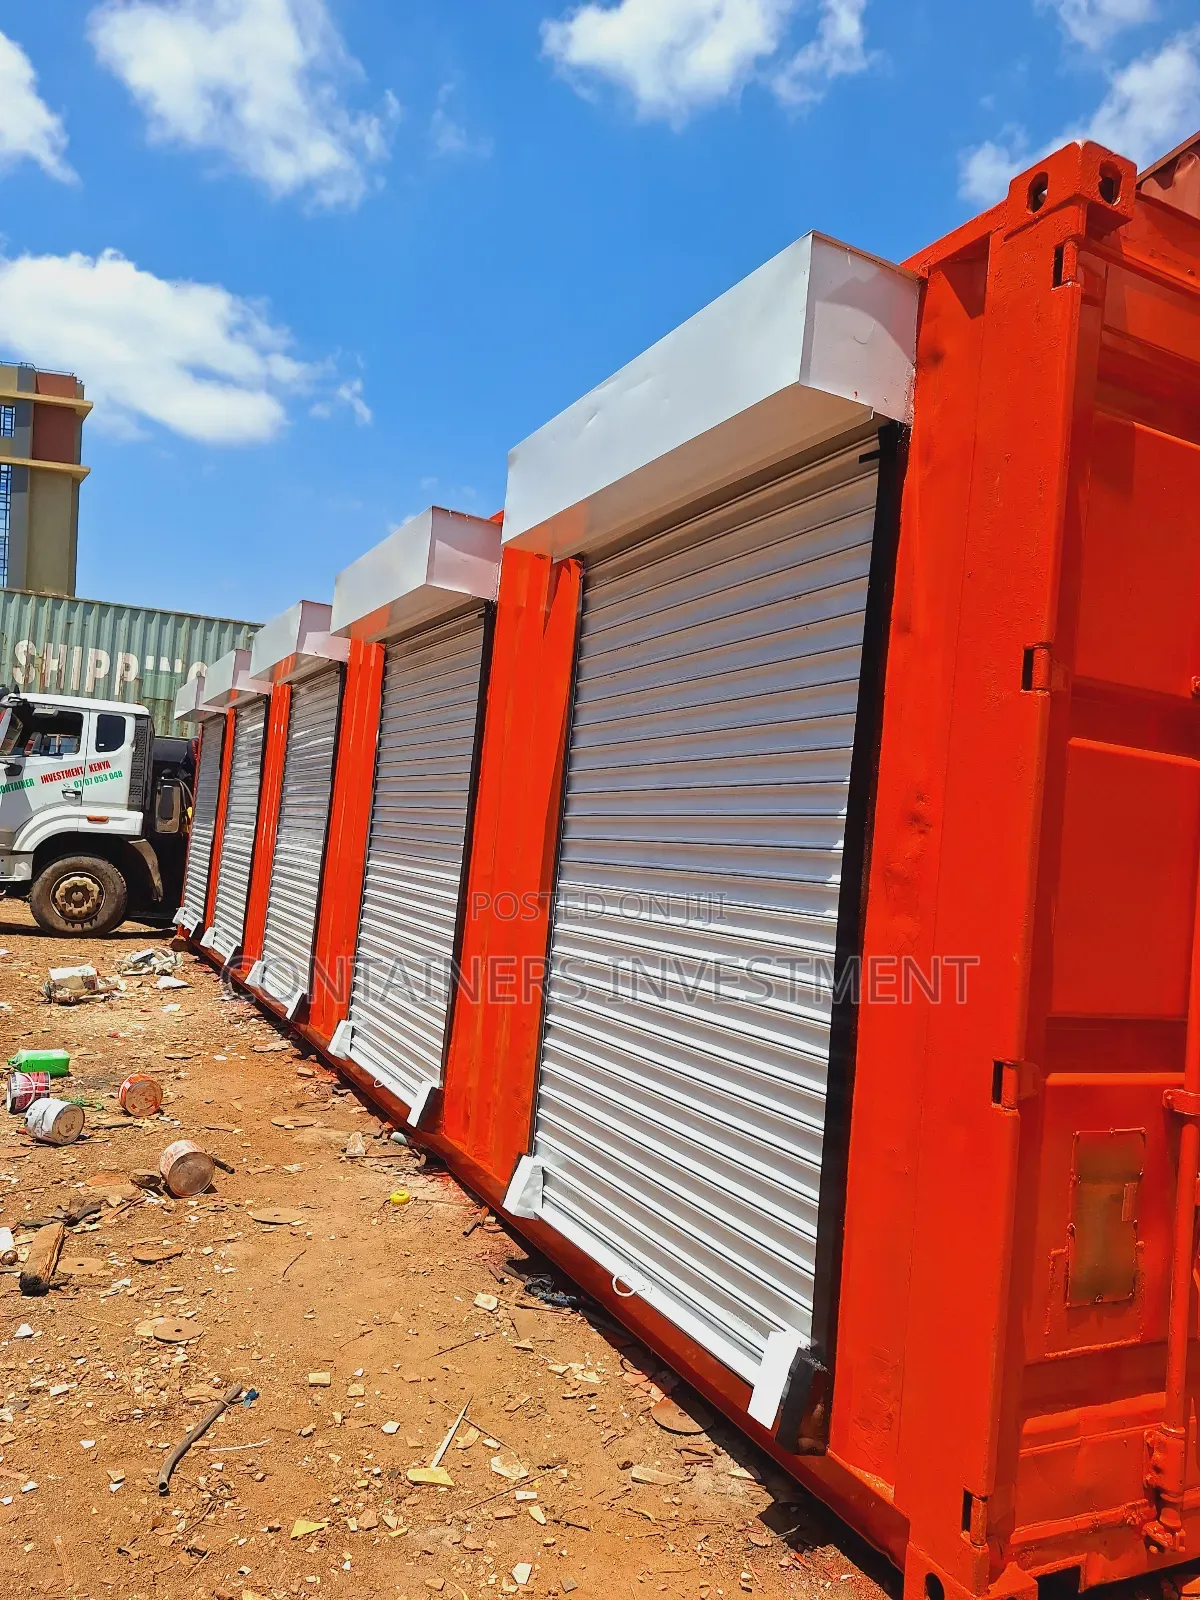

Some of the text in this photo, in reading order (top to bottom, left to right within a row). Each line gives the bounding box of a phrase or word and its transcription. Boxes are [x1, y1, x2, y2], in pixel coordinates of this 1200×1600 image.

[12, 639, 208, 696] SHIPP
[40, 766, 84, 784] INVESTMENT
[88, 760, 111, 773] KENYA
[94, 774, 109, 783] 053
[109, 770, 123, 780] 048
